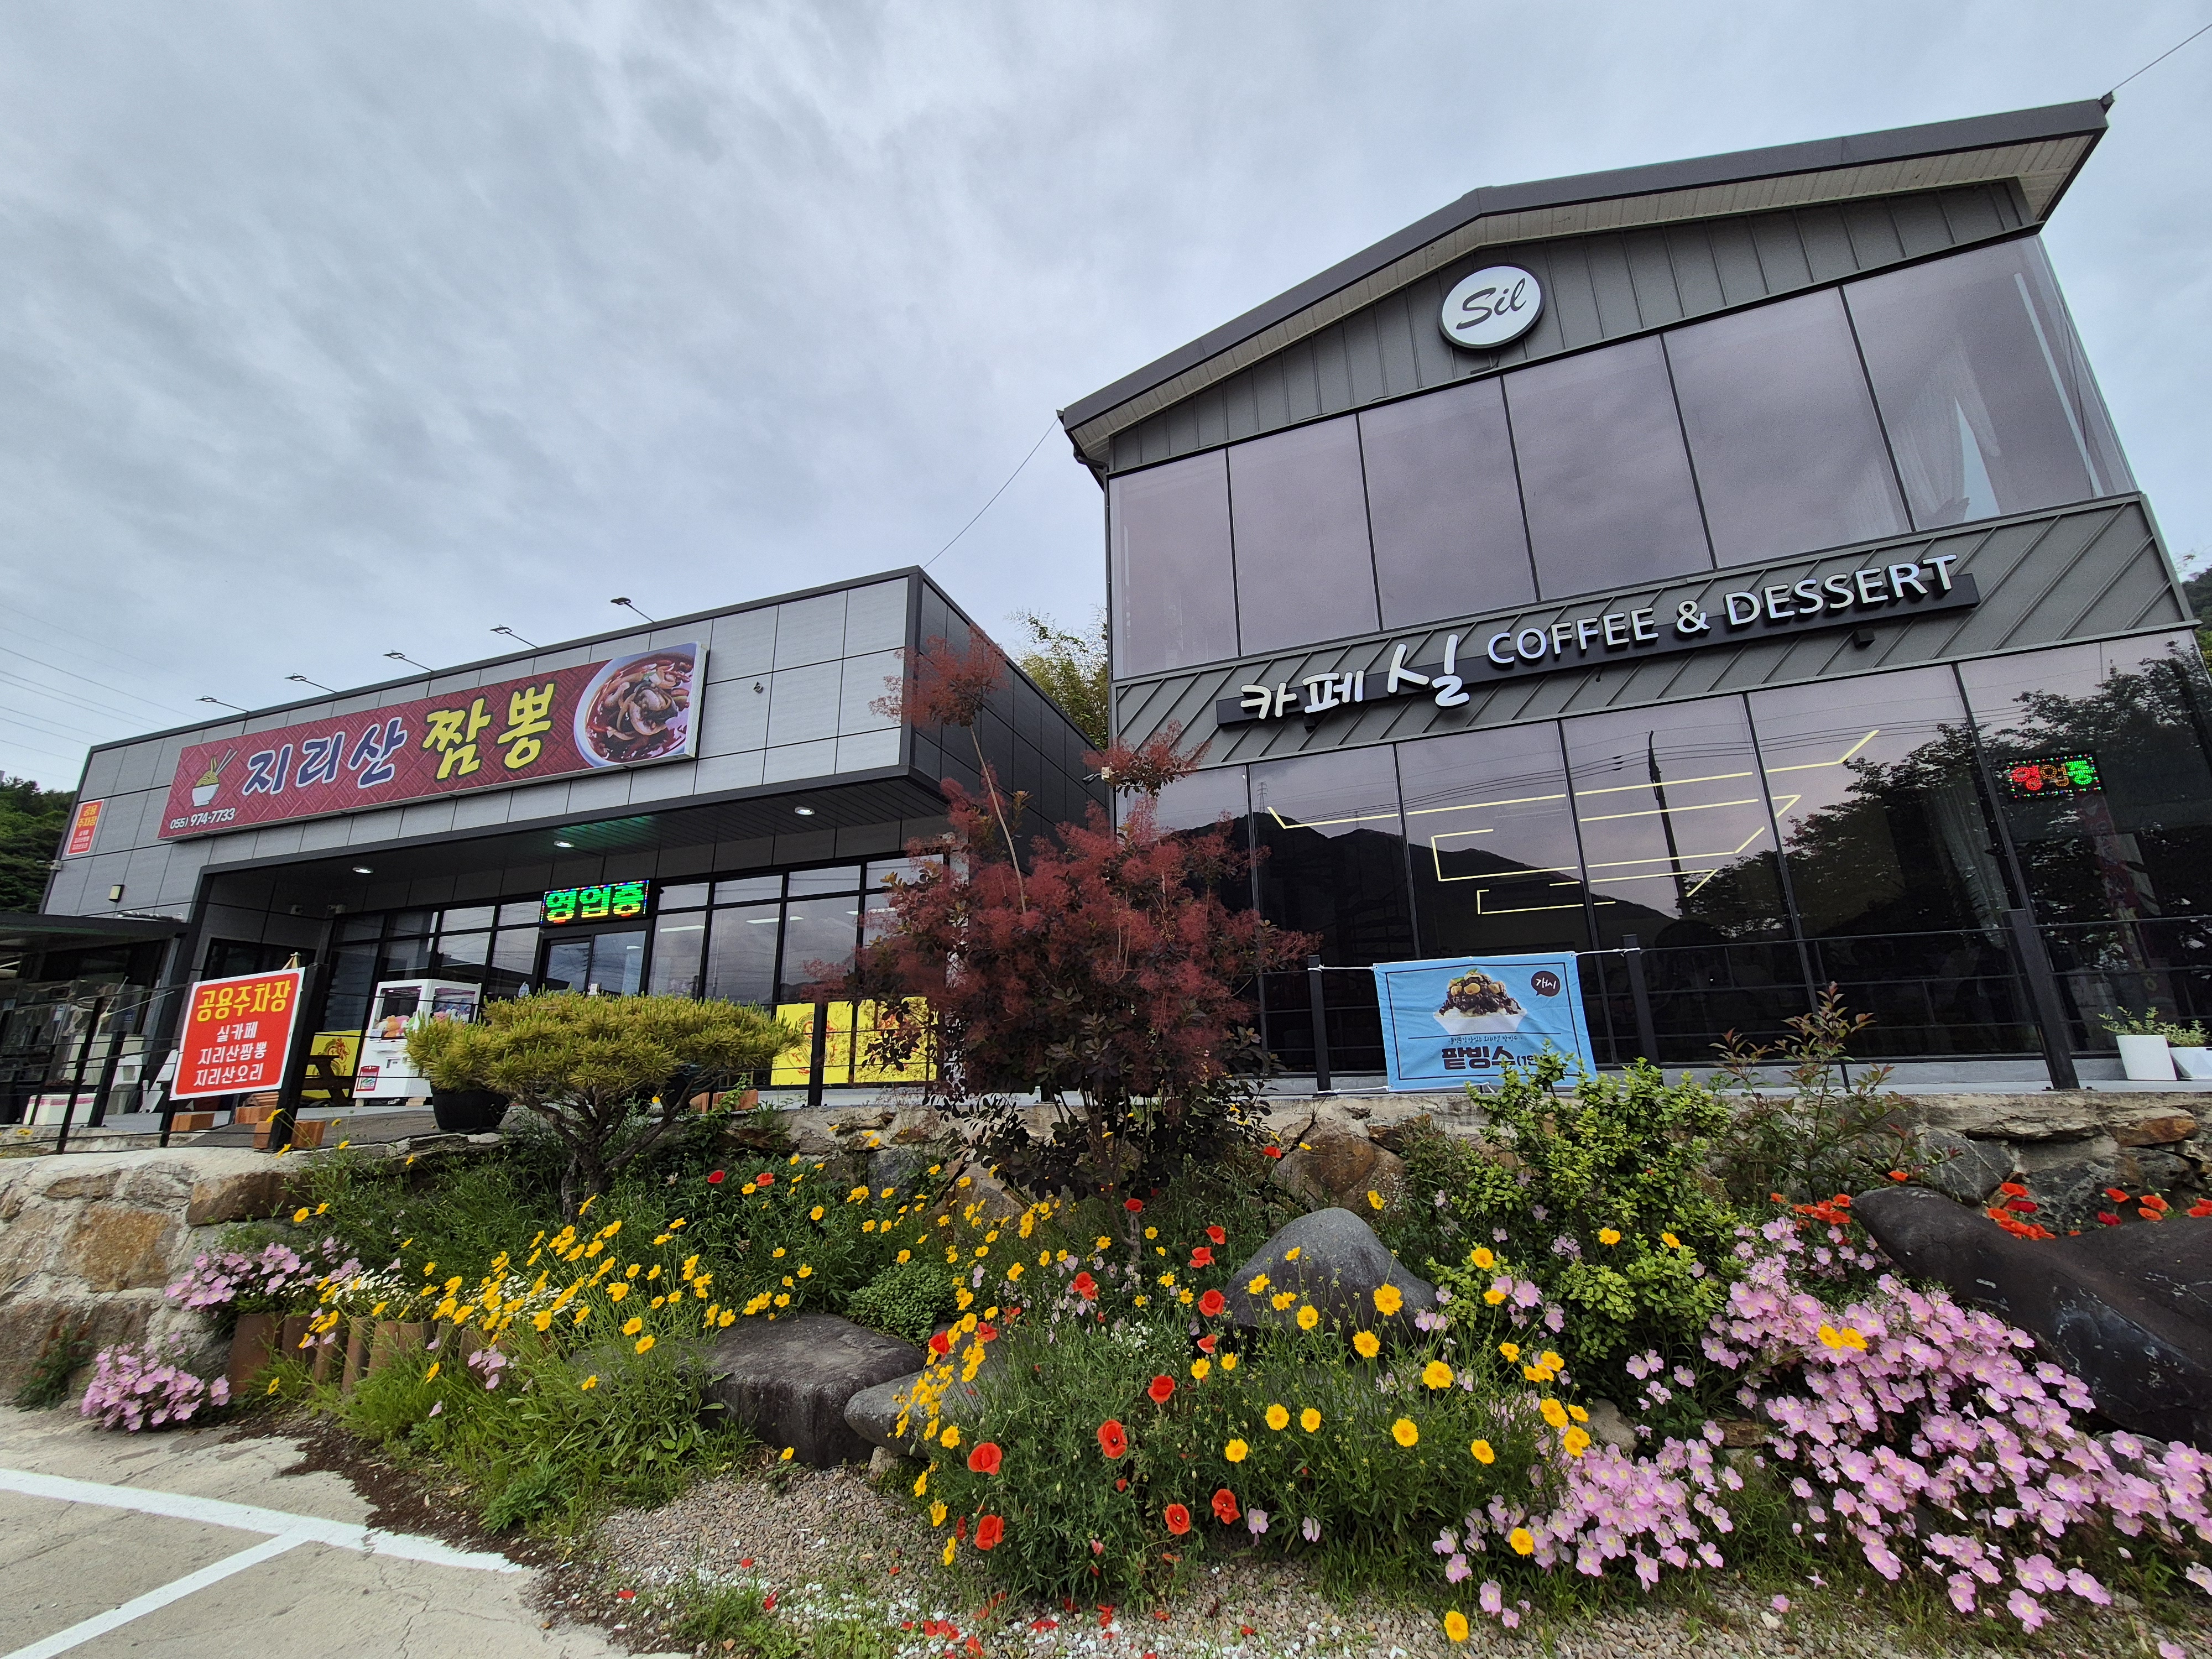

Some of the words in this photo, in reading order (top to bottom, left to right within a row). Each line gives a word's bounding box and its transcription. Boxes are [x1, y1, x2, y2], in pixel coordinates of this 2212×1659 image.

[1456, 278, 1527, 330] Sil
[1240, 670, 1365, 719] 카페
[1387, 634, 1470, 708] 실
[1488, 607, 1660, 665] COFFEE
[1676, 600, 1711, 634] &
[1724, 554, 1958, 625] DESSERT
[242, 716, 408, 796] 지리산
[421, 682, 555, 781] 짬뽕
[77, 816, 97, 828] 주차장
[84, 805, 98, 816] 공용
[170, 816, 189, 830] 055)
[190, 807, 236, 827] 974-7733
[546, 883, 644, 924] 영업중
[1536, 977, 1557, 990] 개시
[197, 979, 291, 1022] 공용주차장
[216, 1021, 259, 1043] 실카페
[197, 1041, 268, 1065] 지리산짬뽕
[1442, 1046, 1516, 1070] 팥빙수
[193, 1062, 264, 1087] 지리산오리
